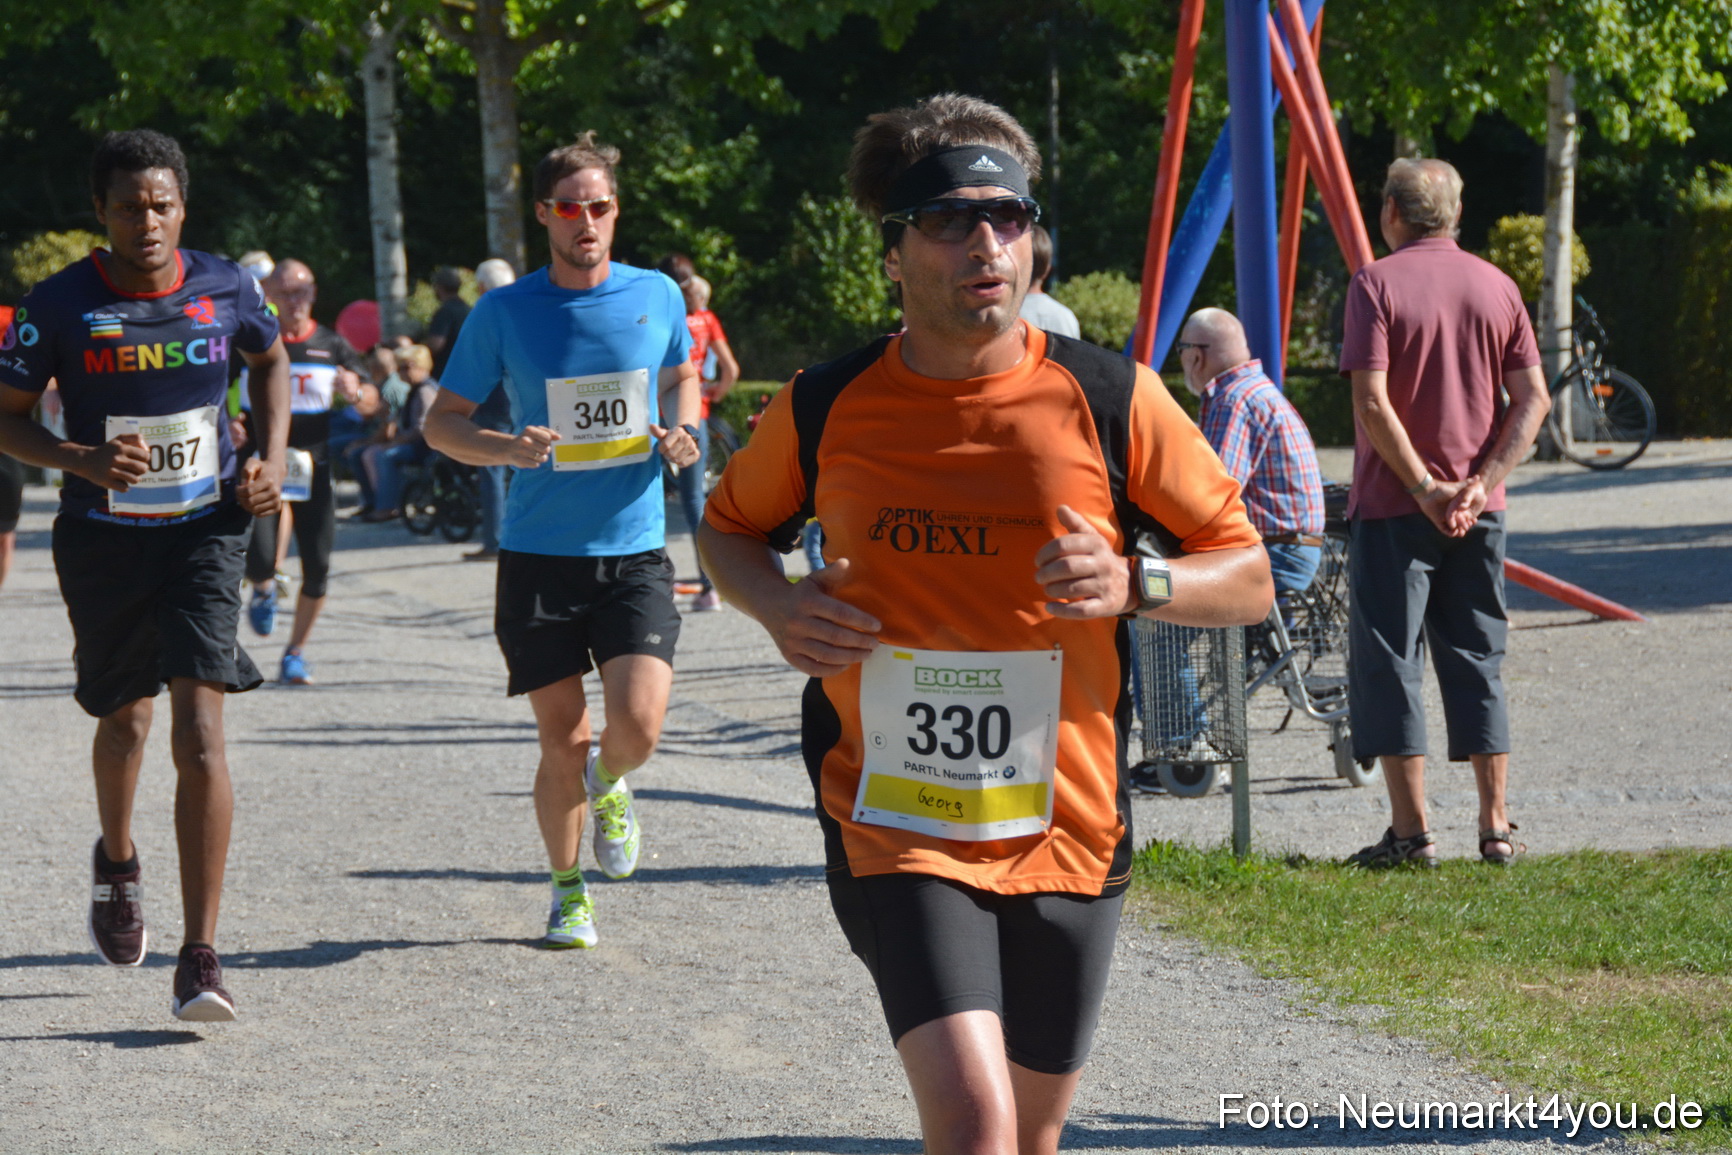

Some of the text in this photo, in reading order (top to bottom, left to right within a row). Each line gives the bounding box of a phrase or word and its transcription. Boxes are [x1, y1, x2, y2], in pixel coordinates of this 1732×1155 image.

[84, 336, 227, 374] MENSCH
[577, 381, 621, 394] BOCK
[574, 399, 628, 430] 340
[139, 422, 188, 436] BOCK
[573, 433, 595, 441] PARTL
[147, 436, 201, 473] 067
[936, 512, 970, 524] UHREN
[973, 515, 993, 525] UND
[996, 517, 1045, 528] SCHMUCK
[889, 522, 999, 556] OEXL
[914, 666, 1003, 689] BOCK
[914, 687, 941, 695] inspired
[906, 702, 1011, 760] 330
[904, 761, 998, 781] PARTL Neumarkt
[918, 787, 964, 818] Georg
